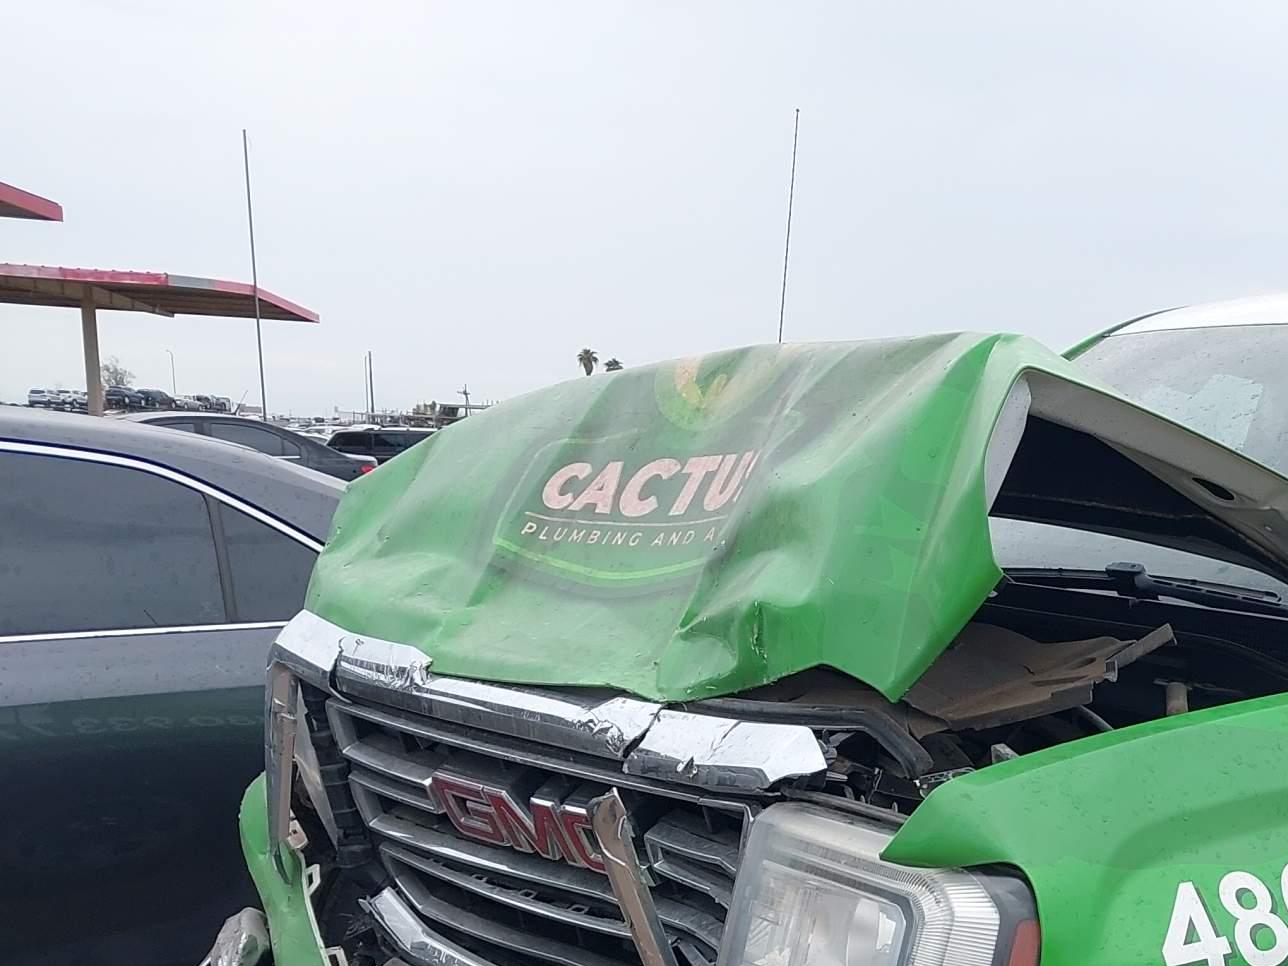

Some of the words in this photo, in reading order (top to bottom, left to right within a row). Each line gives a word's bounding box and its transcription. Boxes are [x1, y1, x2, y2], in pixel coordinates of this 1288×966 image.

[541, 450, 760, 517] CACTU
[520, 521, 643, 547] PLUMBING
[651, 530, 696, 547] AND
[432, 771, 608, 875] GMC
